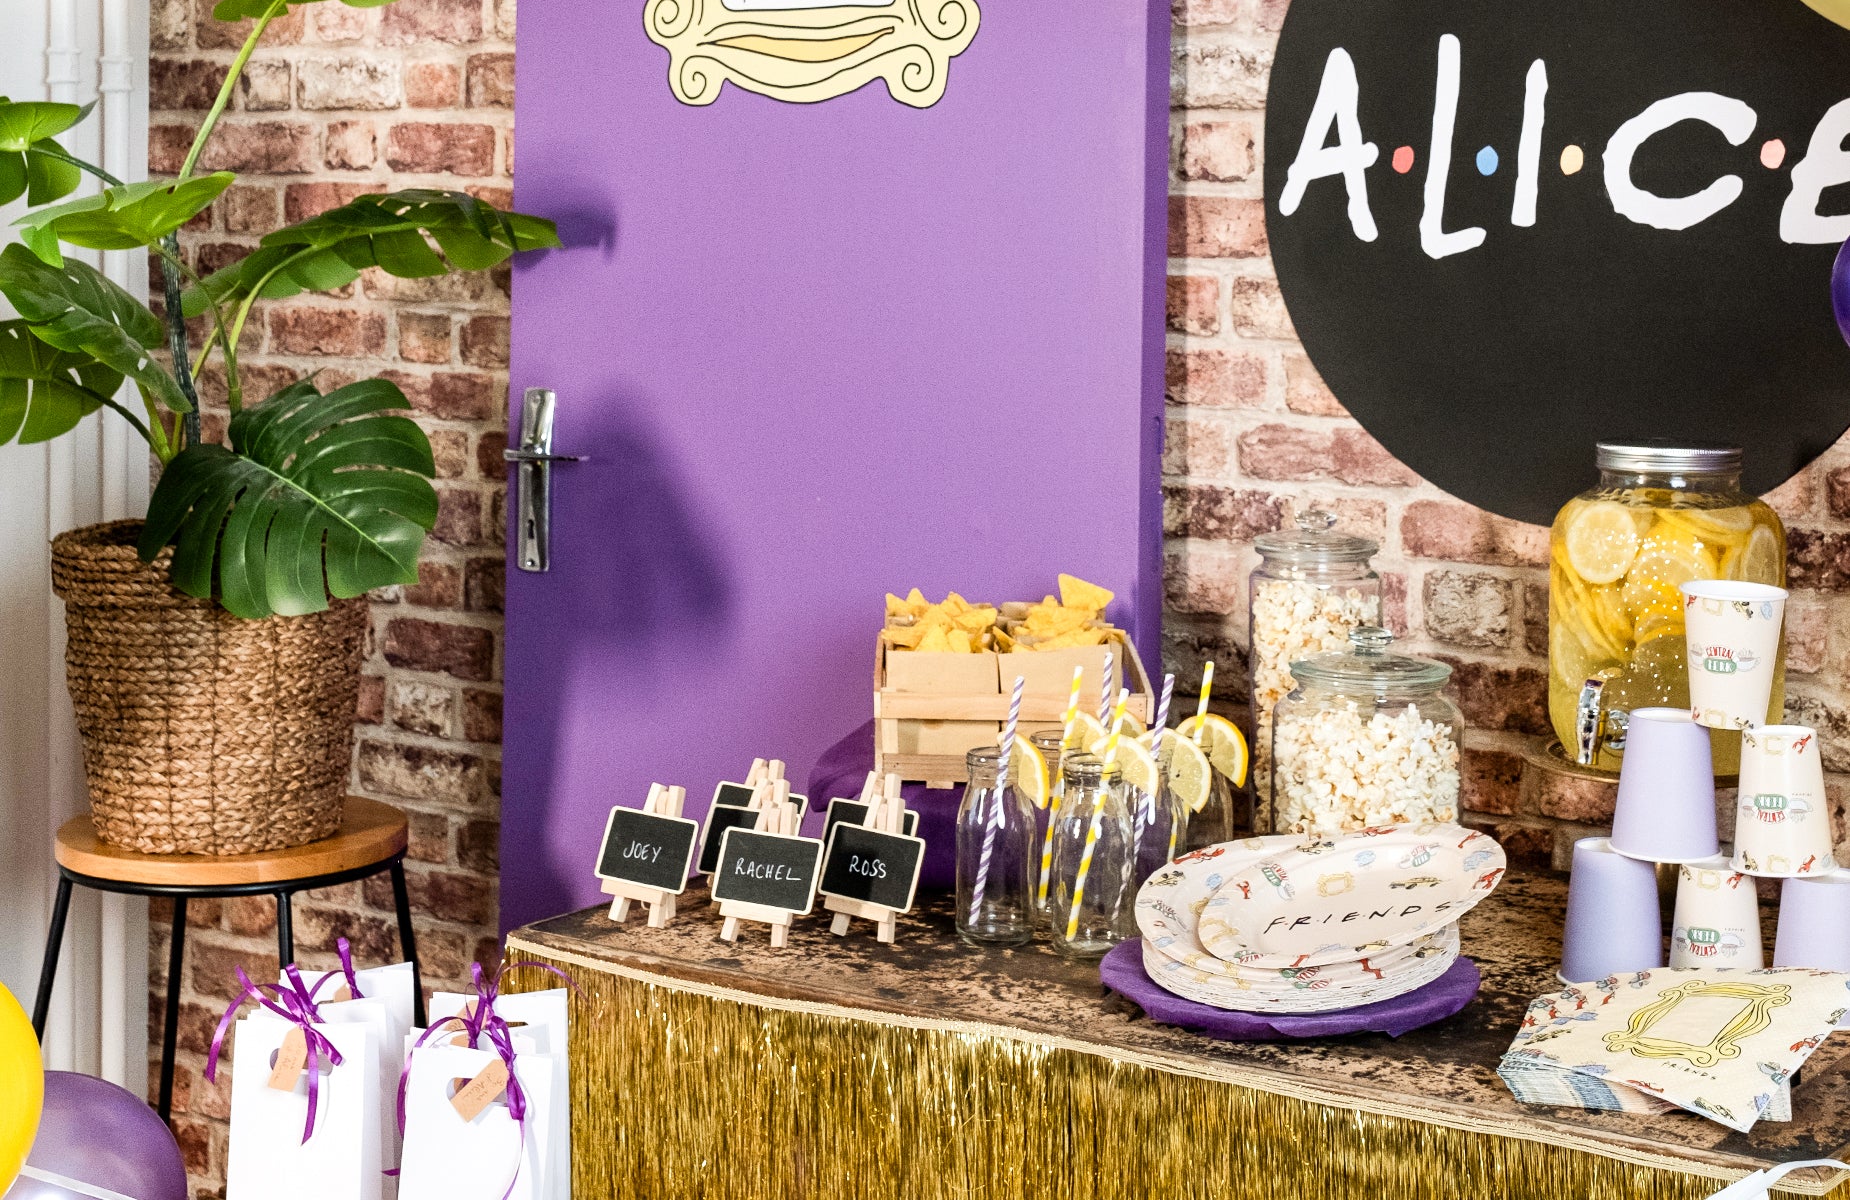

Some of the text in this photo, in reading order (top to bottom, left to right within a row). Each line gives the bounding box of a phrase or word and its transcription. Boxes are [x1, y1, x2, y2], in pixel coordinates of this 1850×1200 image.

[1705, 646, 1735, 659] CENTRAL
[1707, 659, 1733, 672] PERK
[623, 840, 662, 863] JOEY
[735, 857, 802, 882] RACHEL
[849, 855, 887, 879] ROSS
[1689, 942, 1718, 957] CENTRAL
